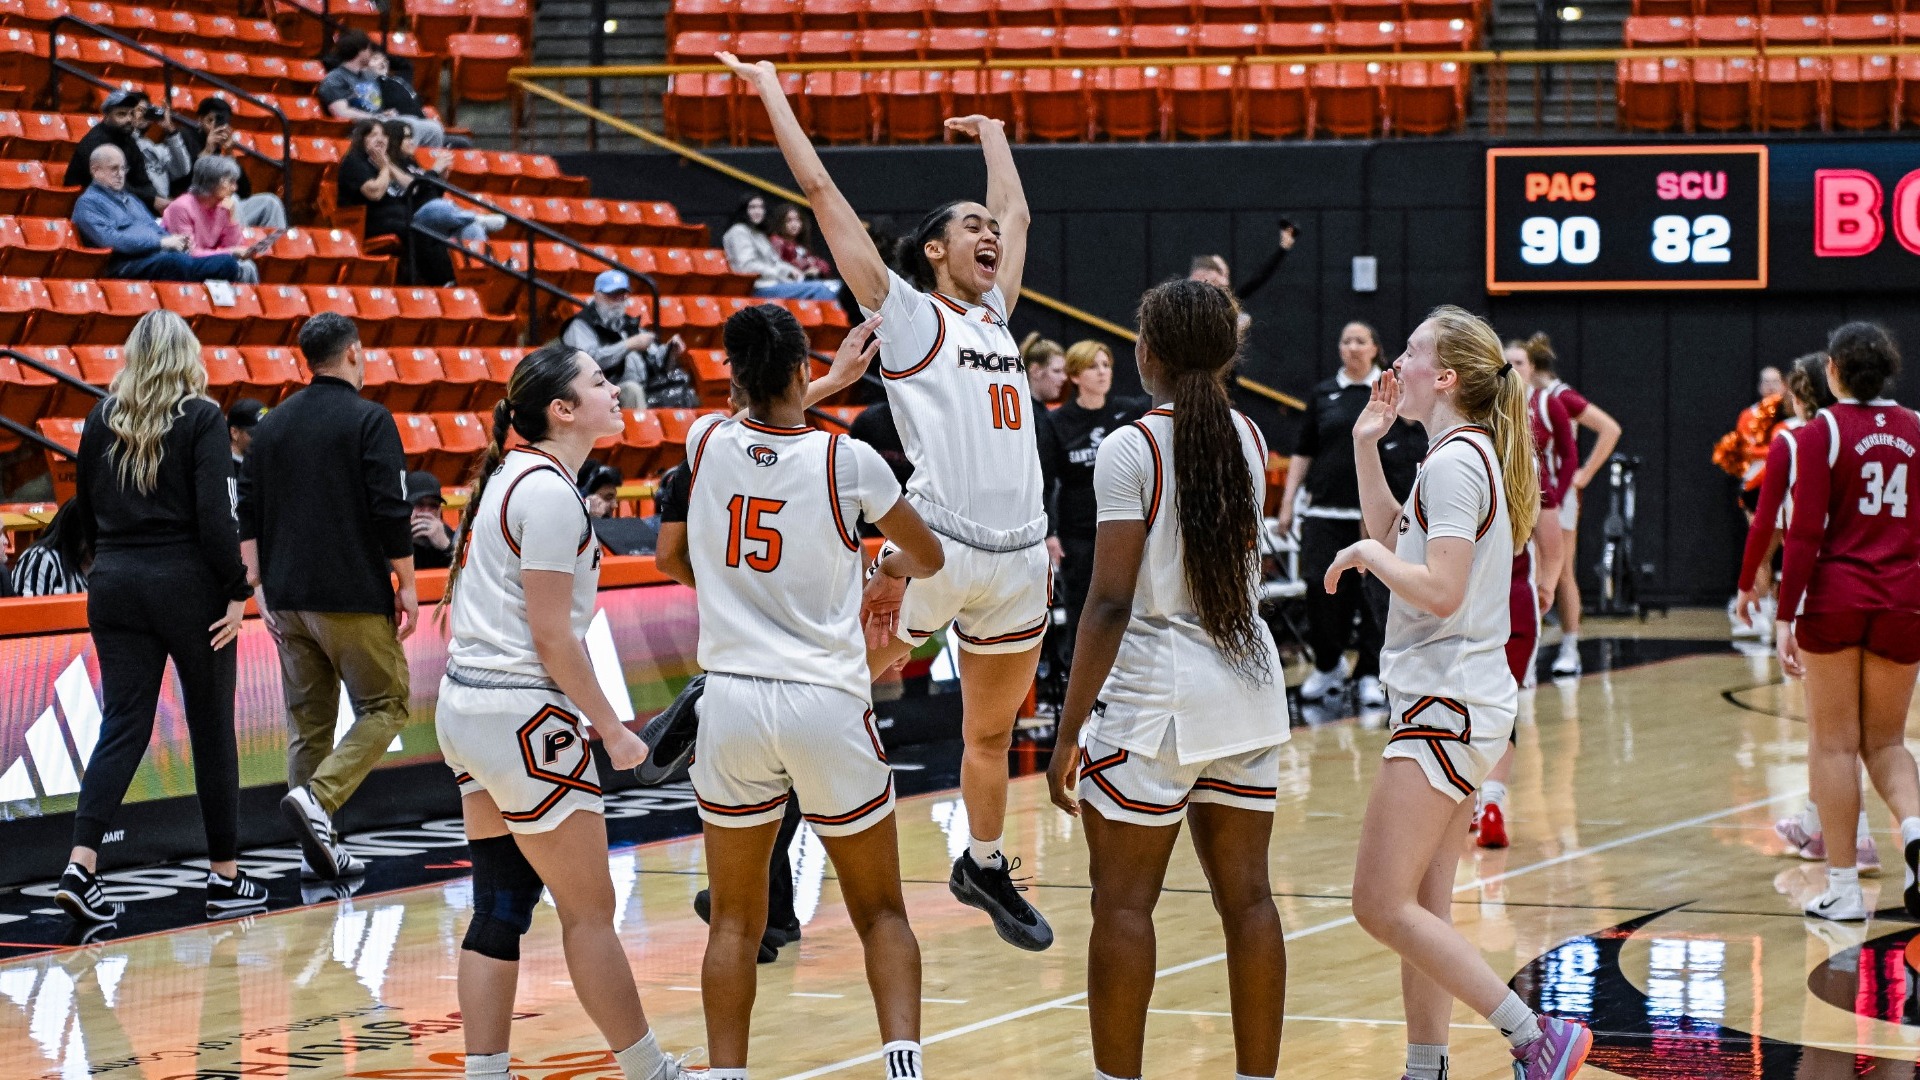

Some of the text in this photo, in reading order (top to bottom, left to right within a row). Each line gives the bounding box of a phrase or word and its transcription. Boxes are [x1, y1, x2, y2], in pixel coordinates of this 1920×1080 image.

[1525, 171, 1728, 203] PAC SCU
[1520, 214, 1731, 265] 90 82
[988, 383, 1021, 430] 10
[1858, 461, 1909, 518] 34
[726, 493, 788, 573] 15
[542, 728, 577, 766] P
